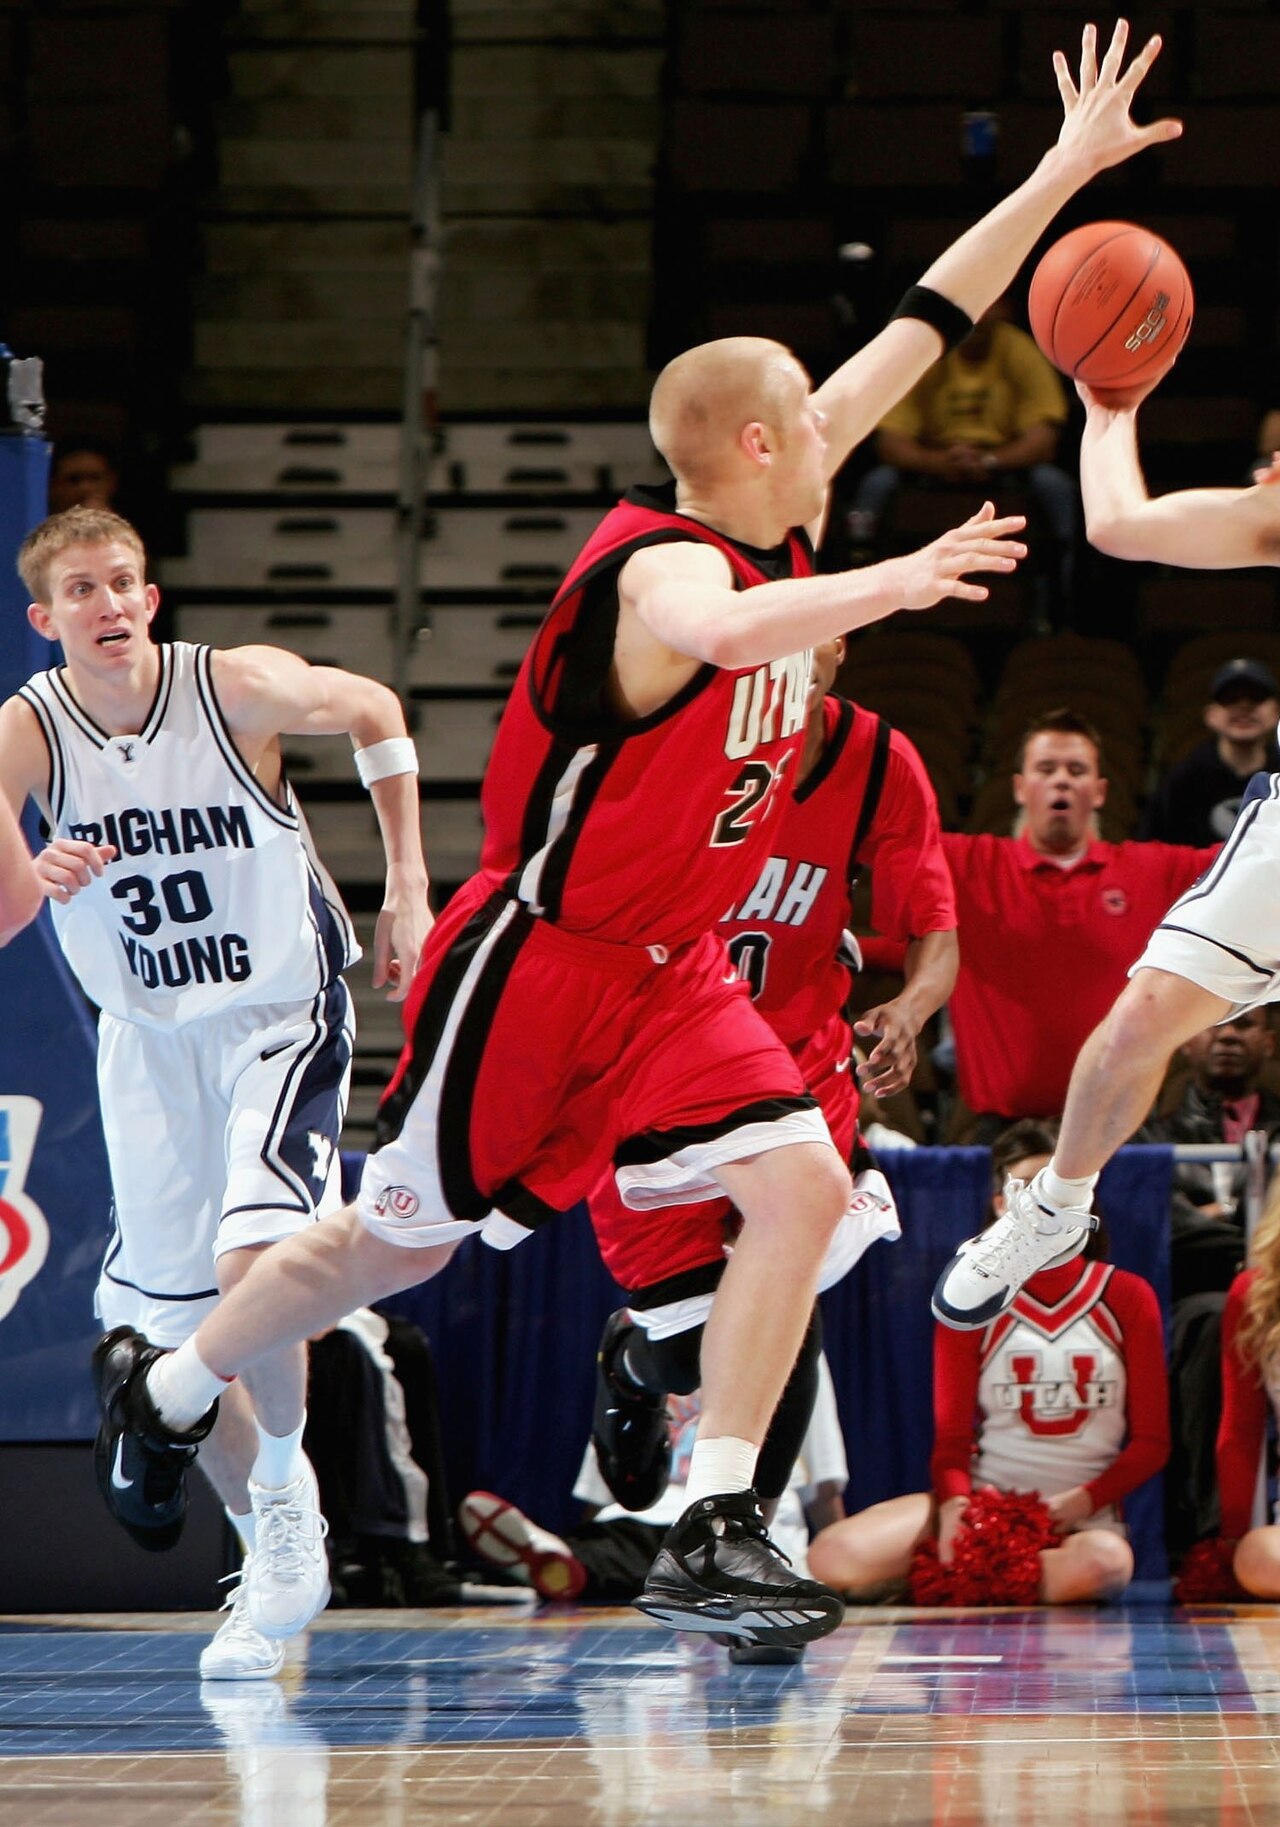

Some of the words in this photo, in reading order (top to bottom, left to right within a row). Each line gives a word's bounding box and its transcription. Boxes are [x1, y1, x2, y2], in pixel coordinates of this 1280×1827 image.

[116, 742, 136, 764] Y
[110, 869, 214, 937] 30
[719, 855, 828, 926] AH
[118, 929, 252, 990] YOUNG
[993, 1381, 1118, 1410] UTAH
